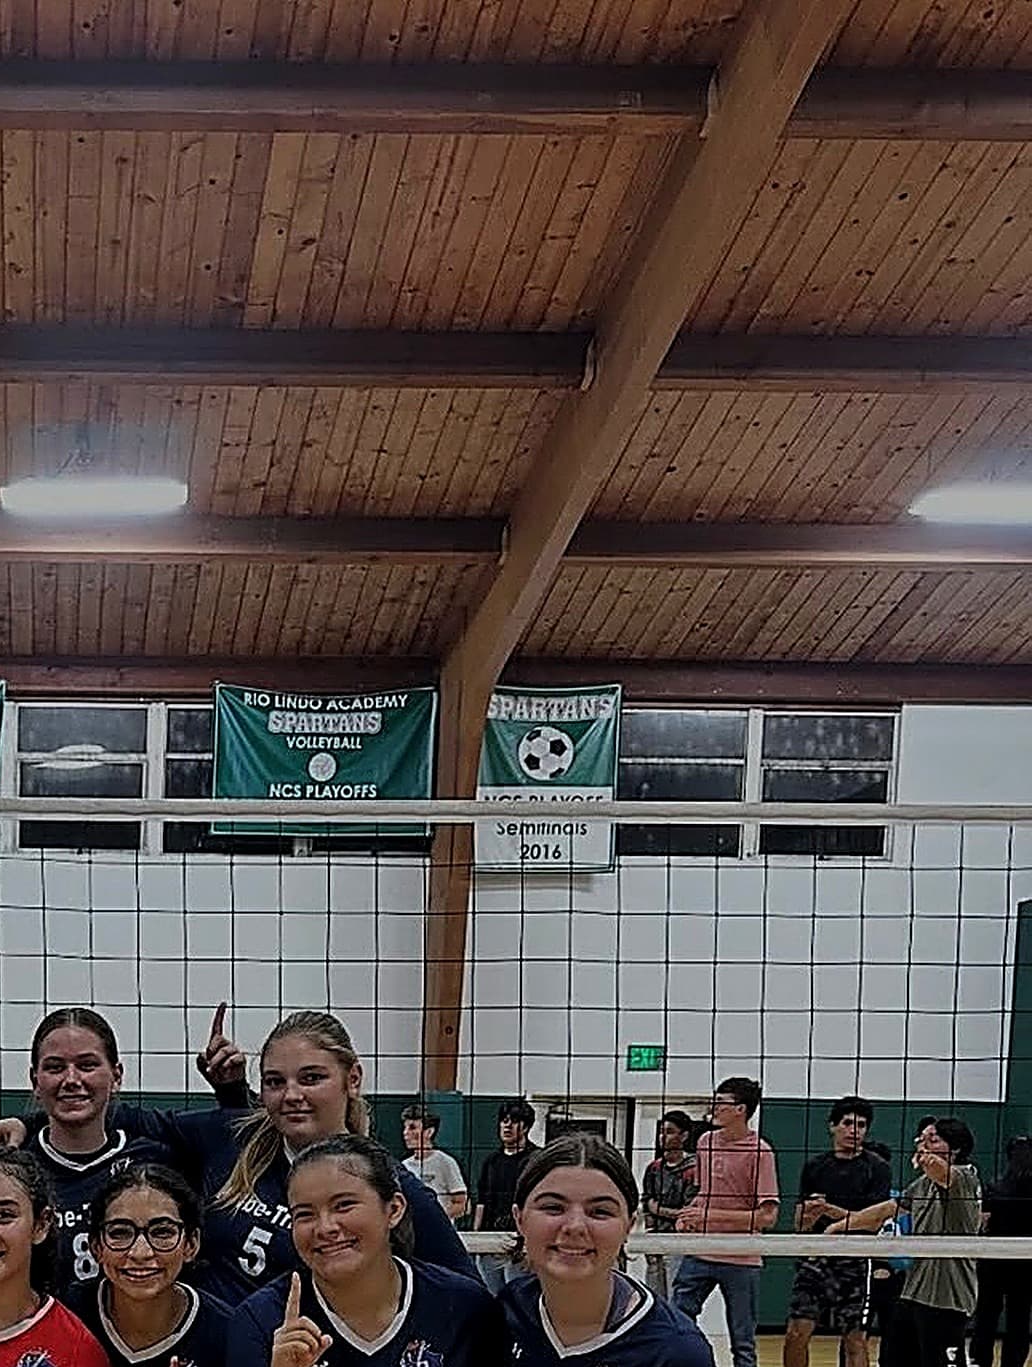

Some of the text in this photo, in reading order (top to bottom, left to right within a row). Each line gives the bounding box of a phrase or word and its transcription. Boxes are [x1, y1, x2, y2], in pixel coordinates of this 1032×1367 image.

[244, 692, 408, 710] RIO LINDO ACADEMY
[487, 694, 615, 721] SPARTANS
[268, 711, 382, 733] SPARTANS
[287, 737, 362, 749] VOLLEYBALL
[269, 784, 377, 798] NCS PLAYOFFS
[521, 844, 561, 859] 2016
[72, 1232, 100, 1281] 8
[237, 1226, 273, 1277] 5
